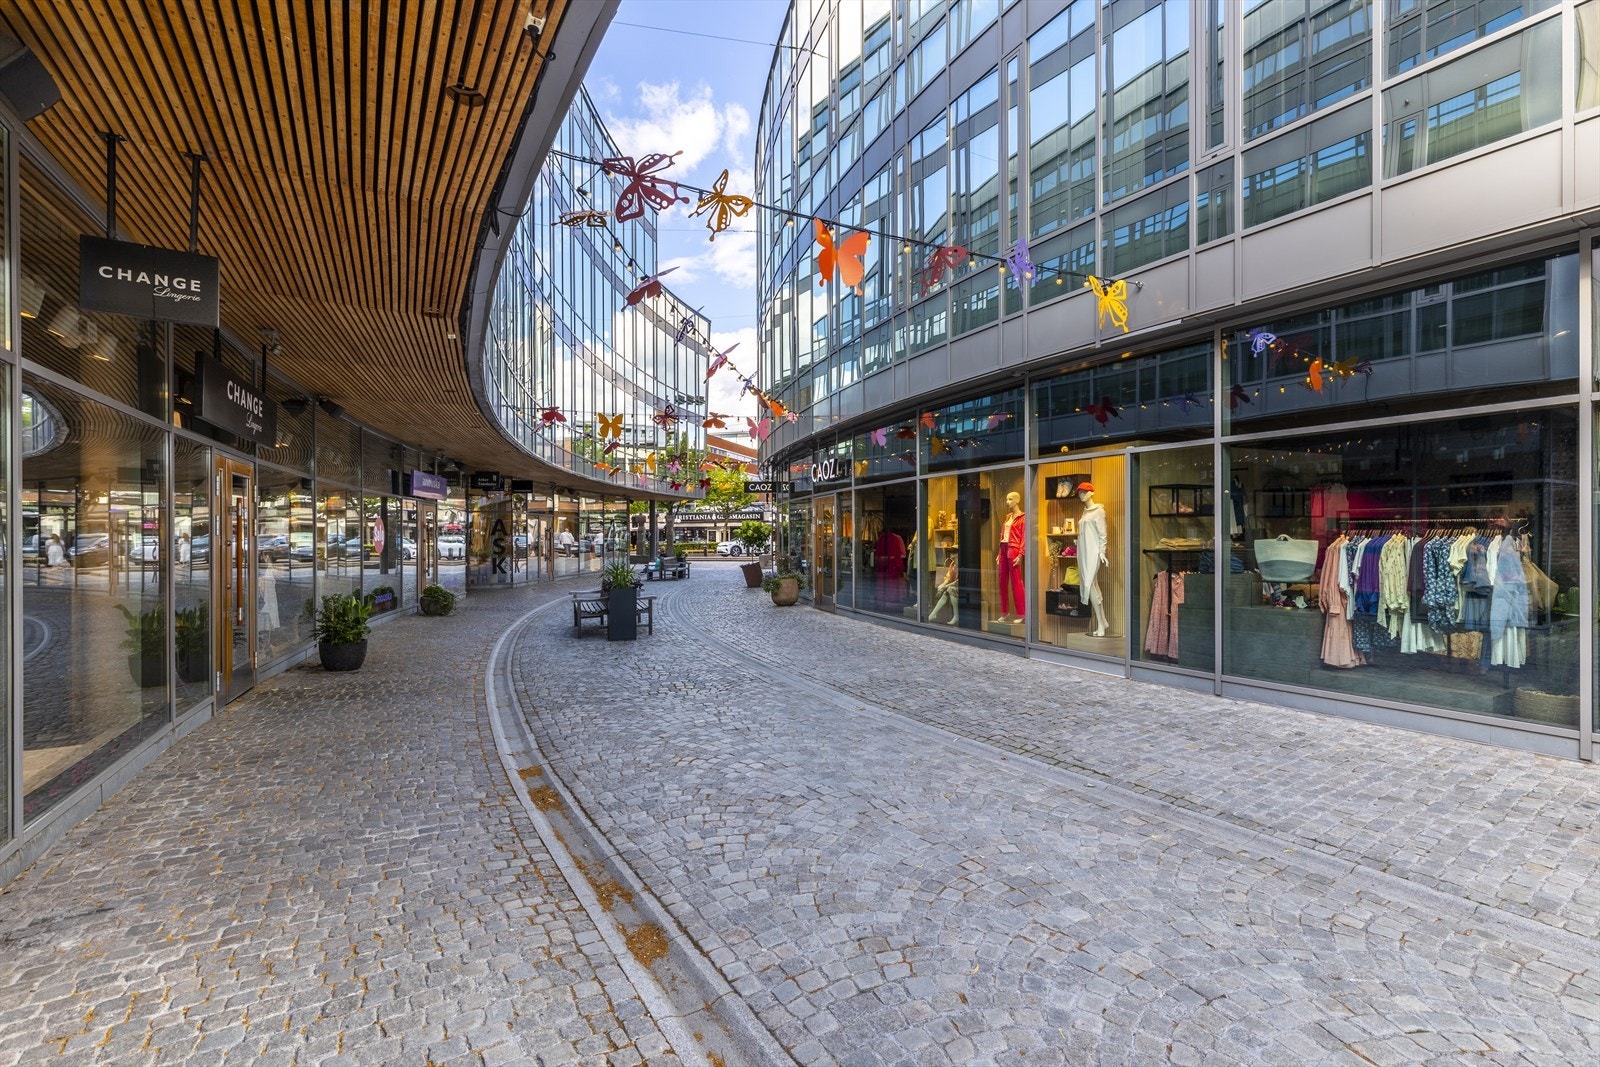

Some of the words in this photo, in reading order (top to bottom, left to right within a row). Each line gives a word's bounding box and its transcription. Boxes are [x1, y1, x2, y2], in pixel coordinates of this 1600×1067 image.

[98, 265, 201, 292] CHANGE
[153, 286, 201, 302] Lingerie
[227, 380, 263, 418] CHANGE
[811, 458, 836, 483] CAOZ
[748, 483, 773, 491] CAOZ
[491, 519, 508, 575] ASK
